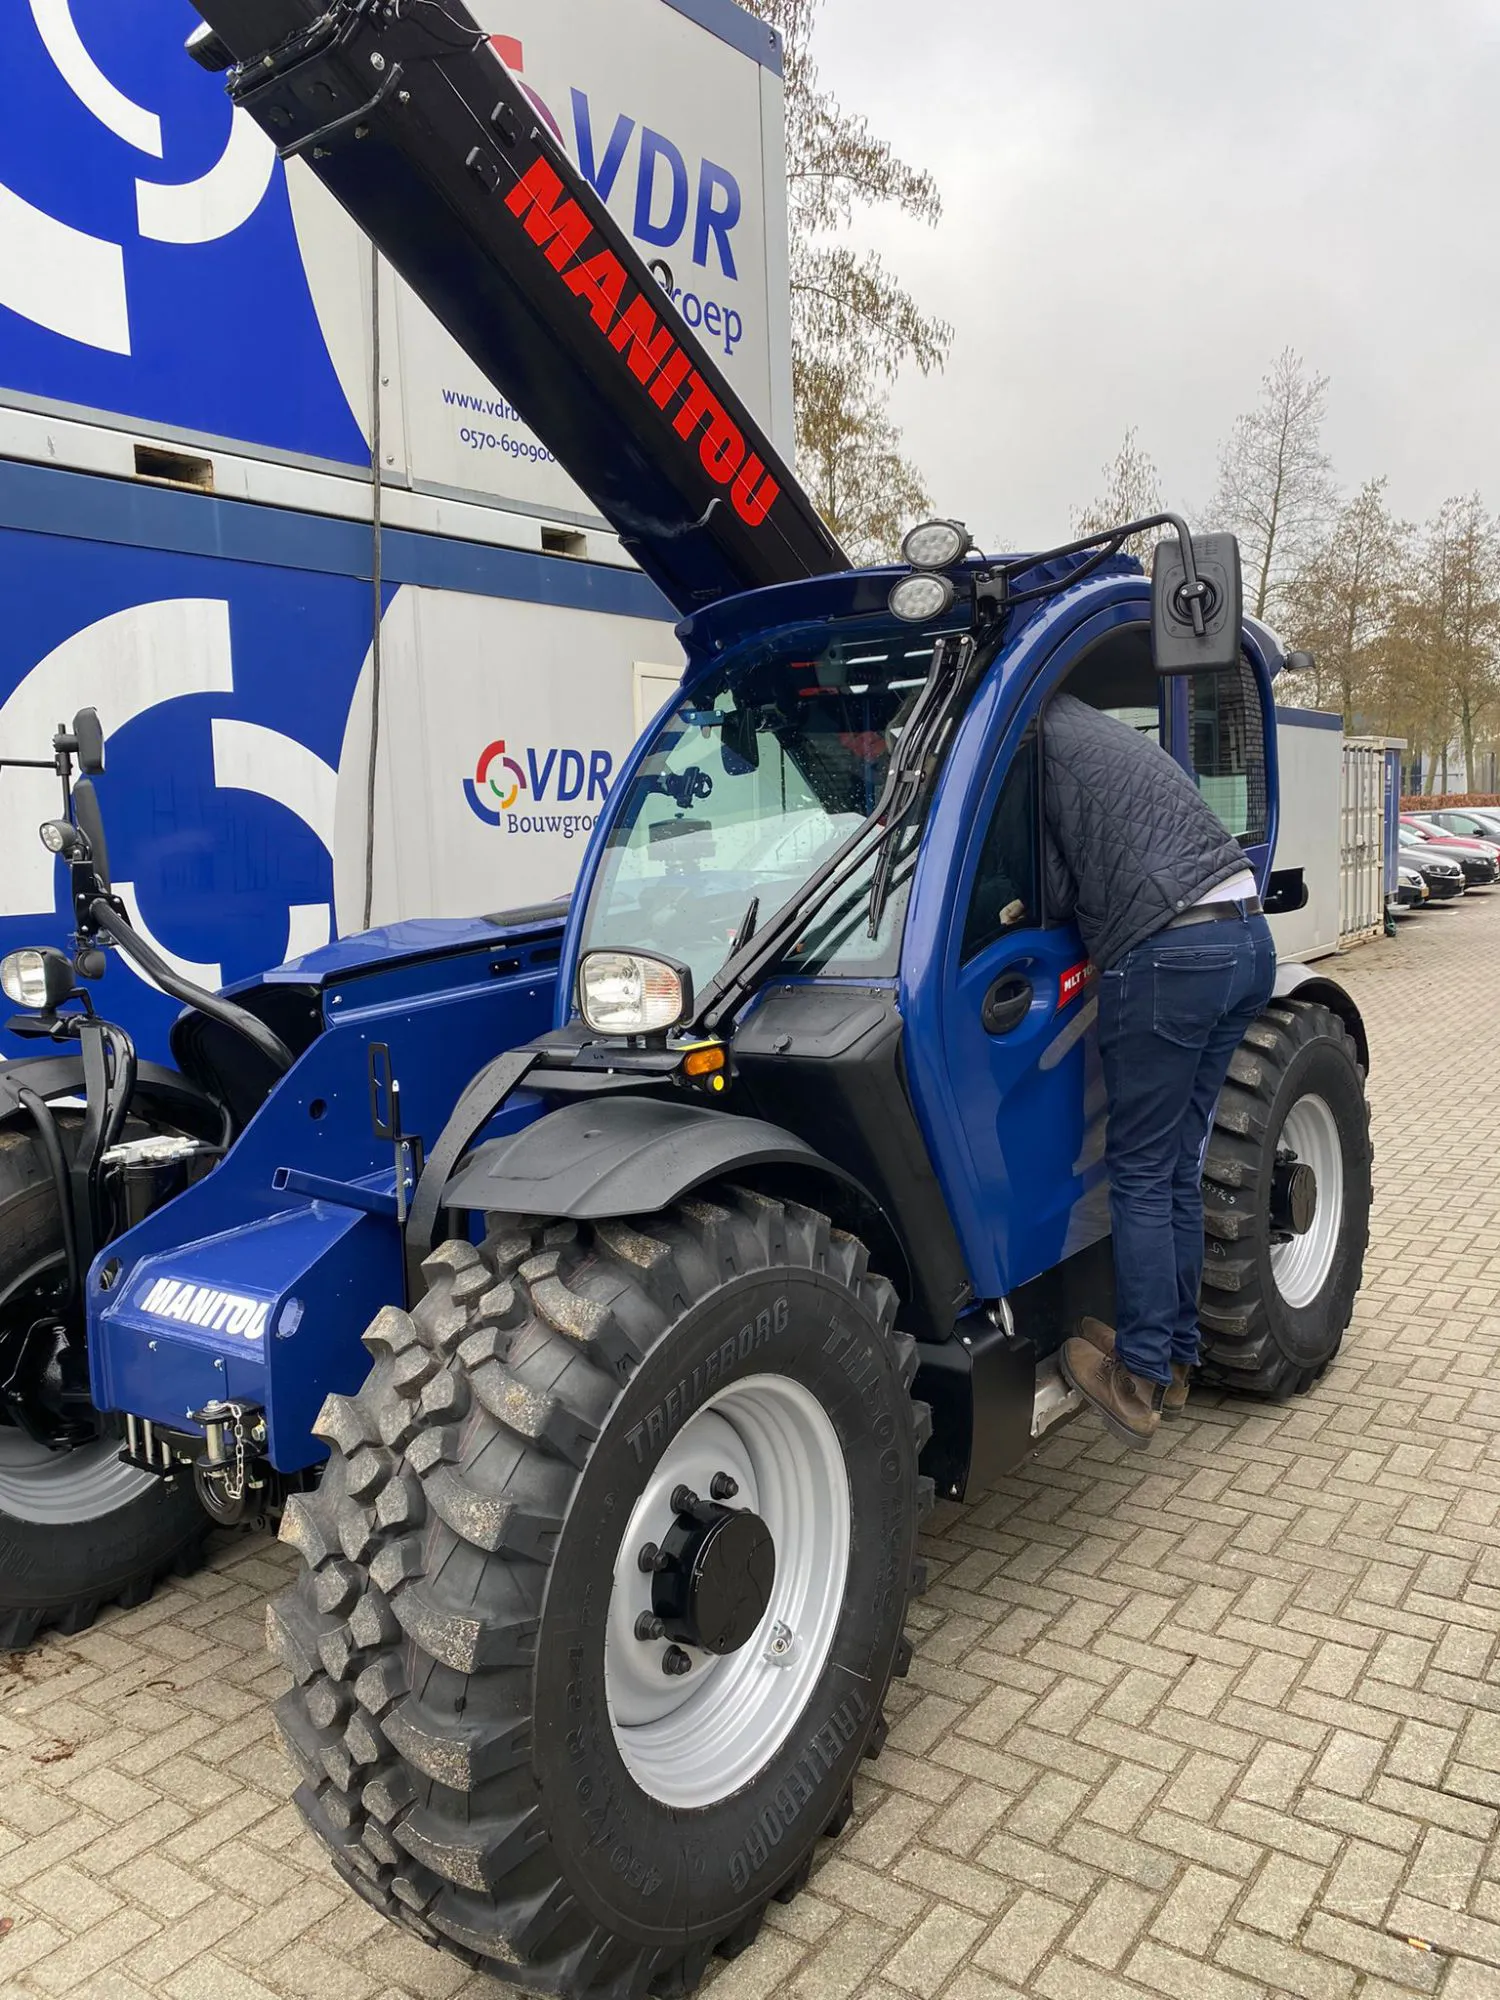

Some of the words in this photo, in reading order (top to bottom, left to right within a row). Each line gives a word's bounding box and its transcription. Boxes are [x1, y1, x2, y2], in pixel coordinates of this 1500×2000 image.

[570, 86, 742, 281] VDR
[504, 156, 780, 527] MANITOU
[657, 281, 743, 356] roep
[442, 388, 520, 422] www.vdrb
[526, 748, 613, 802] VDR
[1064, 971, 1081, 992] MLT
[140, 1277, 272, 1340] MANITOU
[623, 1296, 791, 1464] TRELLEBORG
[728, 1689, 868, 1894] TRELLEBORG
